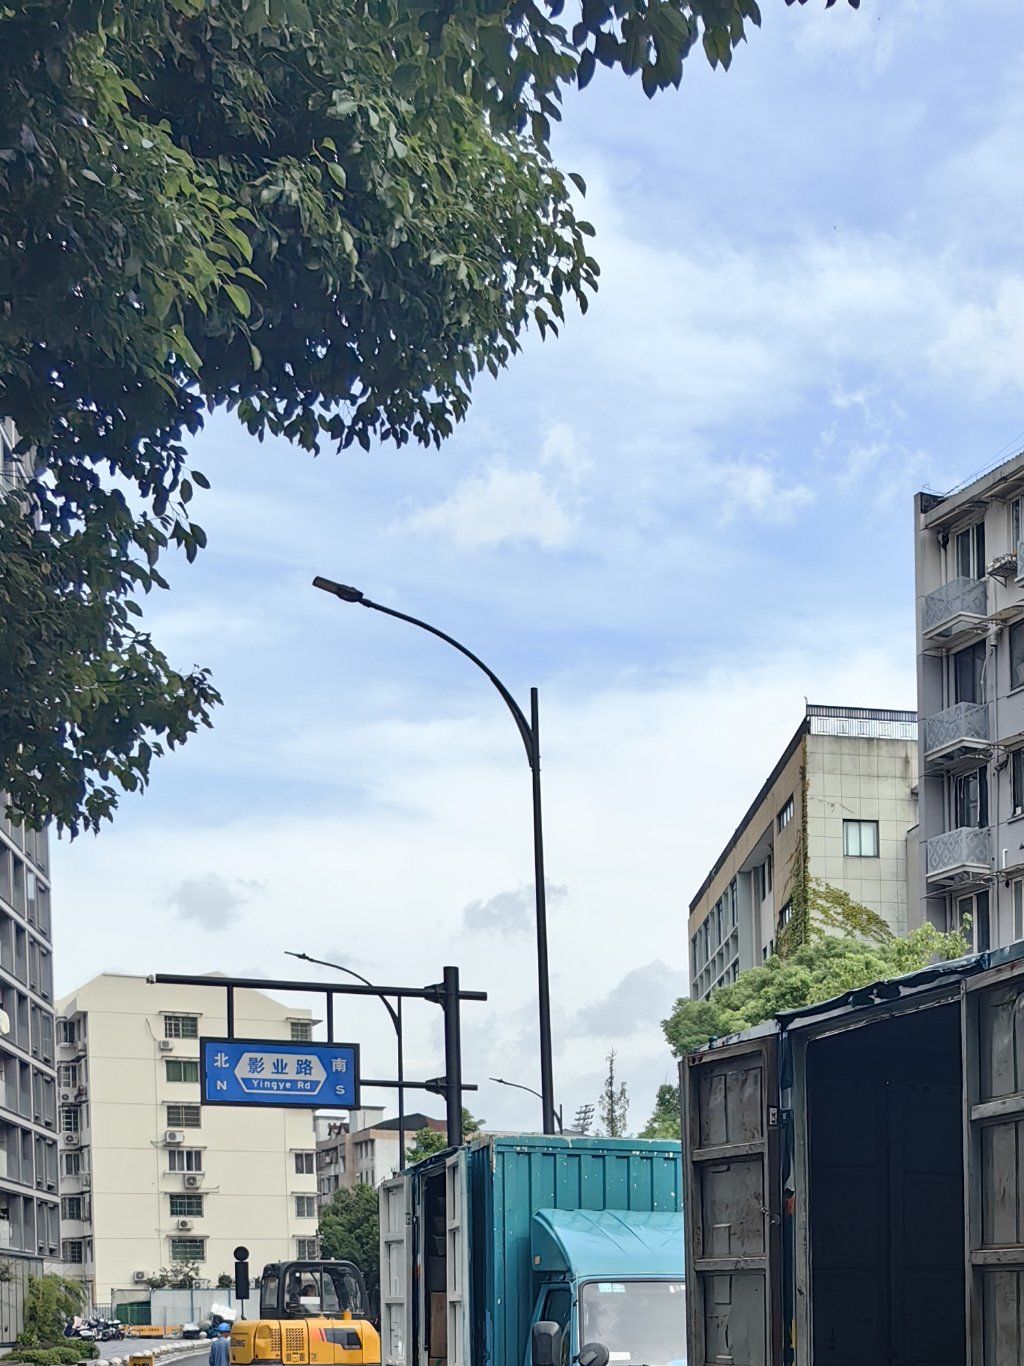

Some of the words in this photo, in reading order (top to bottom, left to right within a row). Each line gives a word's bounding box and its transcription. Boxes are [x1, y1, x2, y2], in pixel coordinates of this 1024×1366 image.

[214, 1052, 229, 1068] 北
[248, 1057, 314, 1075] 影业路
[331, 1058, 347, 1073] 南
[216, 1081, 227, 1090] N
[252, 1080, 291, 1090] Yingye
[297, 1081, 311, 1090] Rd
[336, 1085, 345, 1095] S
